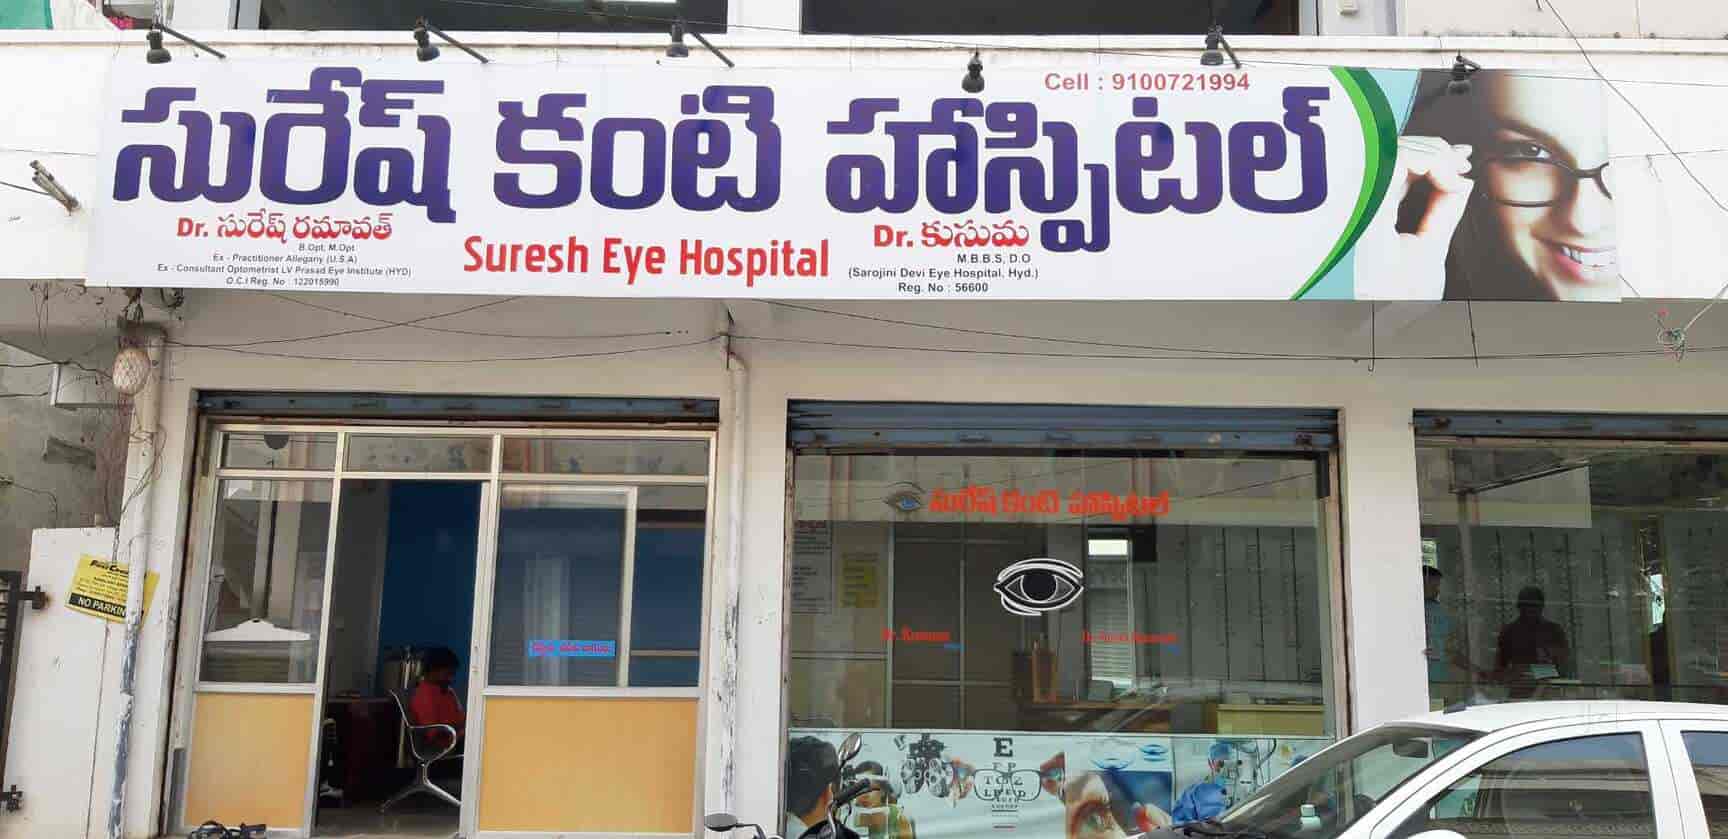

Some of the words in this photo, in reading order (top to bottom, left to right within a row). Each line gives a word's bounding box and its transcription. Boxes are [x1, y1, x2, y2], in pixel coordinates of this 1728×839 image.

[1044, 73, 1088, 90] Cell
[1112, 73, 1250, 90] 9100721994
[112, 66, 456, 224] సురేష్
[493, 85, 783, 213] కంటి
[826, 86, 1330, 253] హాస్పిటల్
[177, 217, 208, 237] Dr.
[873, 224, 914, 247] Dr.
[920, 220, 1030, 248] కుసుమ
[232, 254, 284, 263] Practitioner
[463, 235, 589, 273] Suresh
[602, 237, 666, 286] Eye
[679, 238, 830, 288] Hospital
[176, 264, 225, 272] Consultant
[227, 264, 279, 274] Optometrist
[346, 267, 383, 276] Institute
[848, 267, 897, 279] (Sarojini
[900, 268, 926, 279] Devi
[929, 268, 950, 281] Eye
[1008, 268, 1040, 280] Hyd.)
[928, 283, 944, 292] No
[955, 283, 989, 293] 56600
[78, 596, 92, 607] NO
[93, 600, 127, 617] PARKIN
[993, 737, 1013, 757] E
